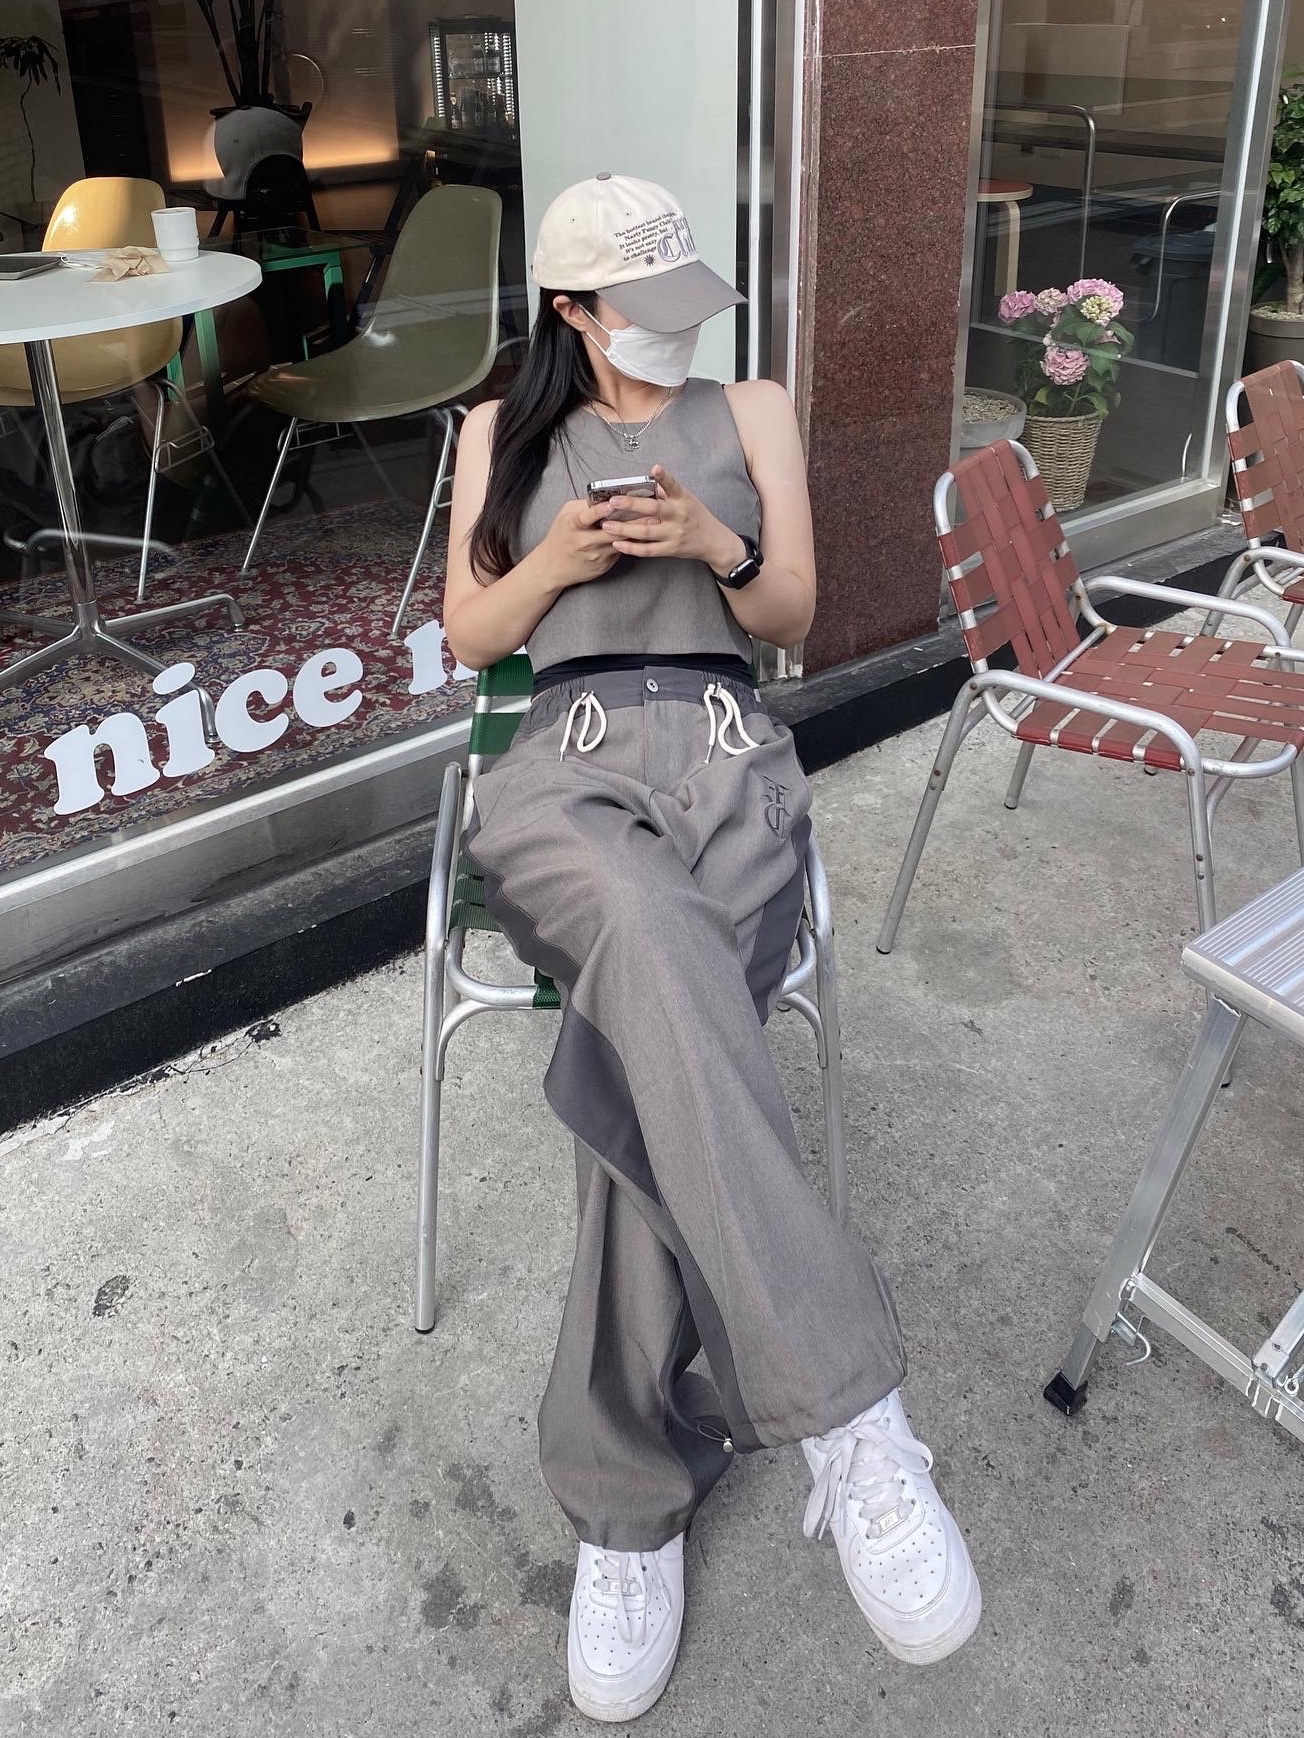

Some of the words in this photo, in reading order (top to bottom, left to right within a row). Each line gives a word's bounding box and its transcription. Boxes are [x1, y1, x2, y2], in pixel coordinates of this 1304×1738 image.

[624, 230, 642, 241] Nasty
[642, 224, 659, 235] Fancy
[626, 223, 646, 234] hottest
[646, 215, 662, 226] brand
[625, 238, 641, 248] looks
[635, 243, 645, 251] not
[645, 239, 657, 248] easy
[43, 647, 364, 815] nice
